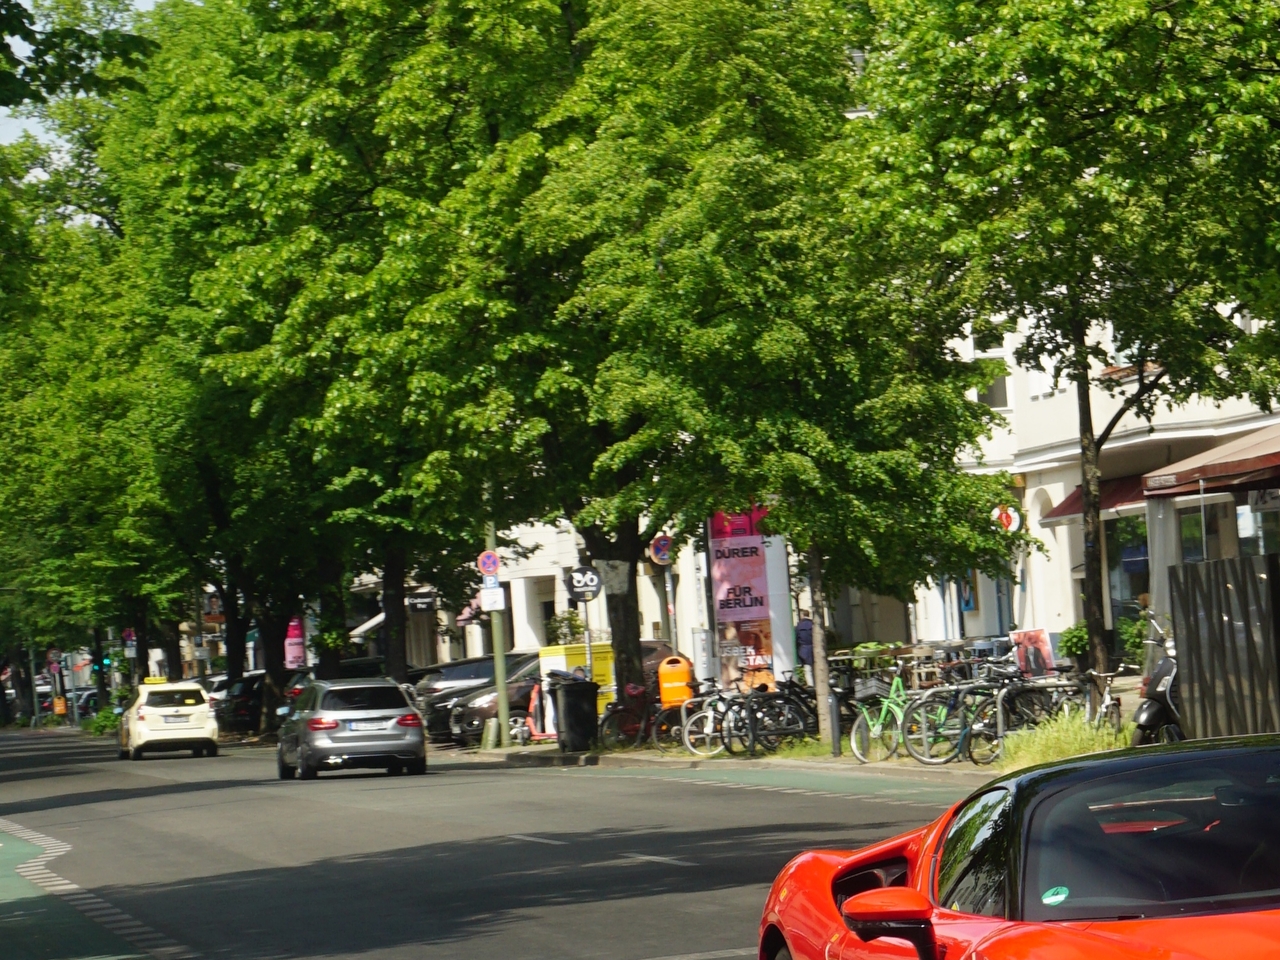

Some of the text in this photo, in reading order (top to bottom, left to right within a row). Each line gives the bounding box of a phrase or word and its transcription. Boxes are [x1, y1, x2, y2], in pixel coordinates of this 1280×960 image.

[715, 547, 759, 560] DÜRER
[727, 585, 752, 598] FÜR
[719, 596, 763, 610] BERLIN
